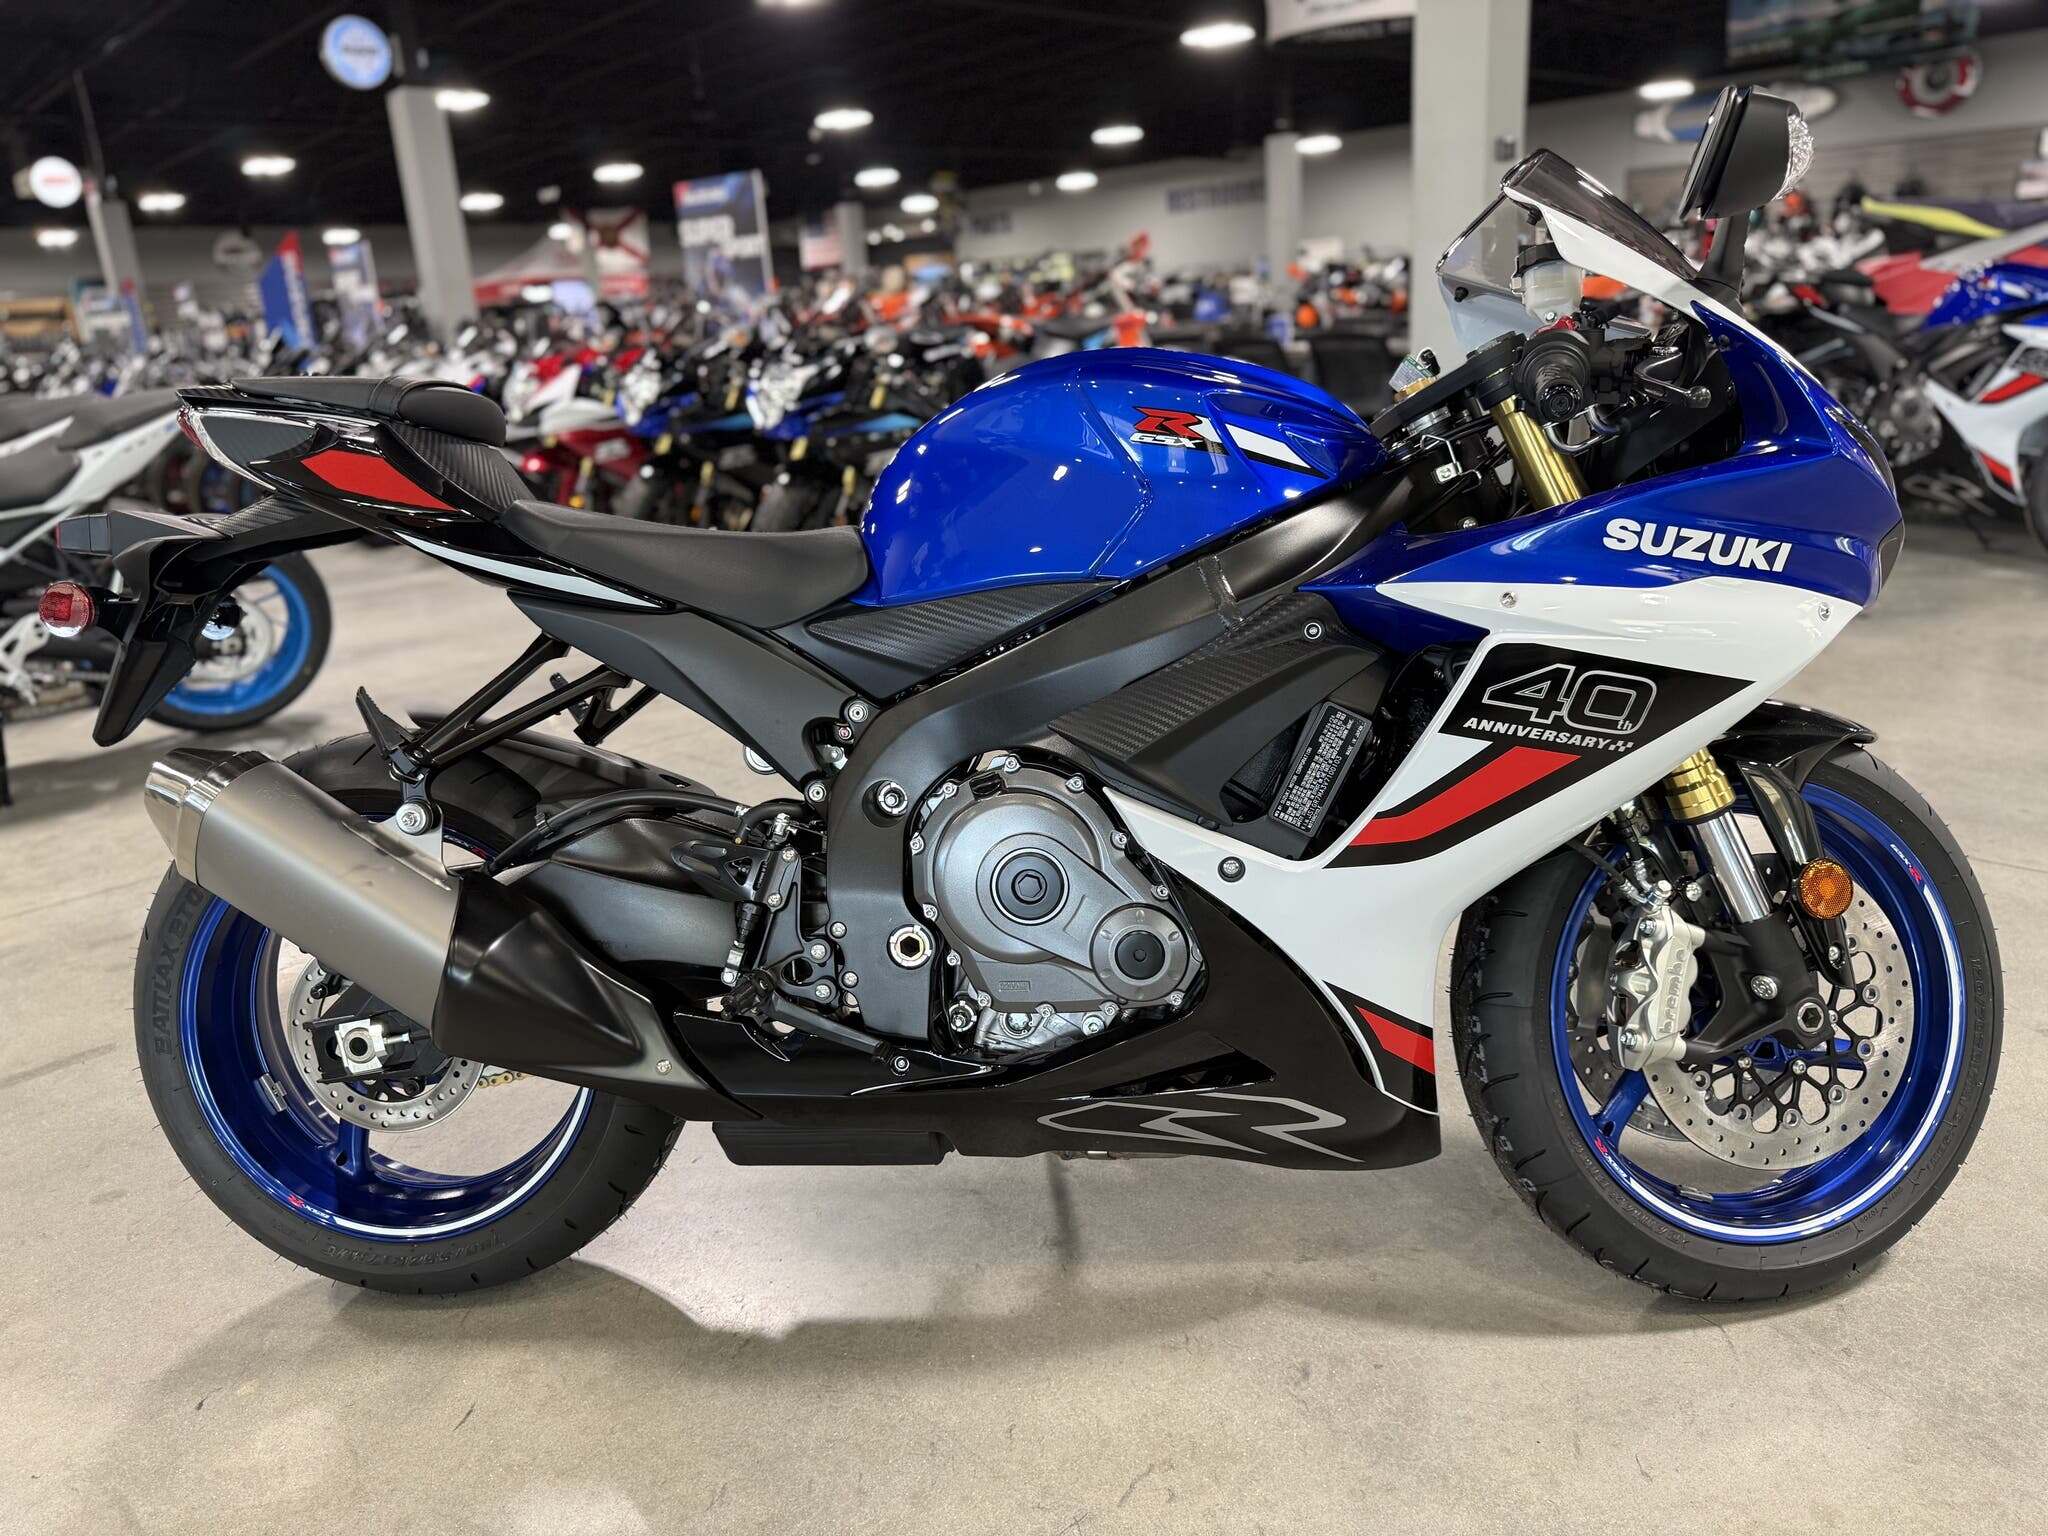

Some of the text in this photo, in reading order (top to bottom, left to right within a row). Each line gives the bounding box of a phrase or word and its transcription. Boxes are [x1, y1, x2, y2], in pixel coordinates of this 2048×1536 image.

[1602, 517, 1793, 573] SUZUKI
[1462, 717, 1611, 751] ANNIVERSARY
[1658, 948, 1686, 1034] brembo
